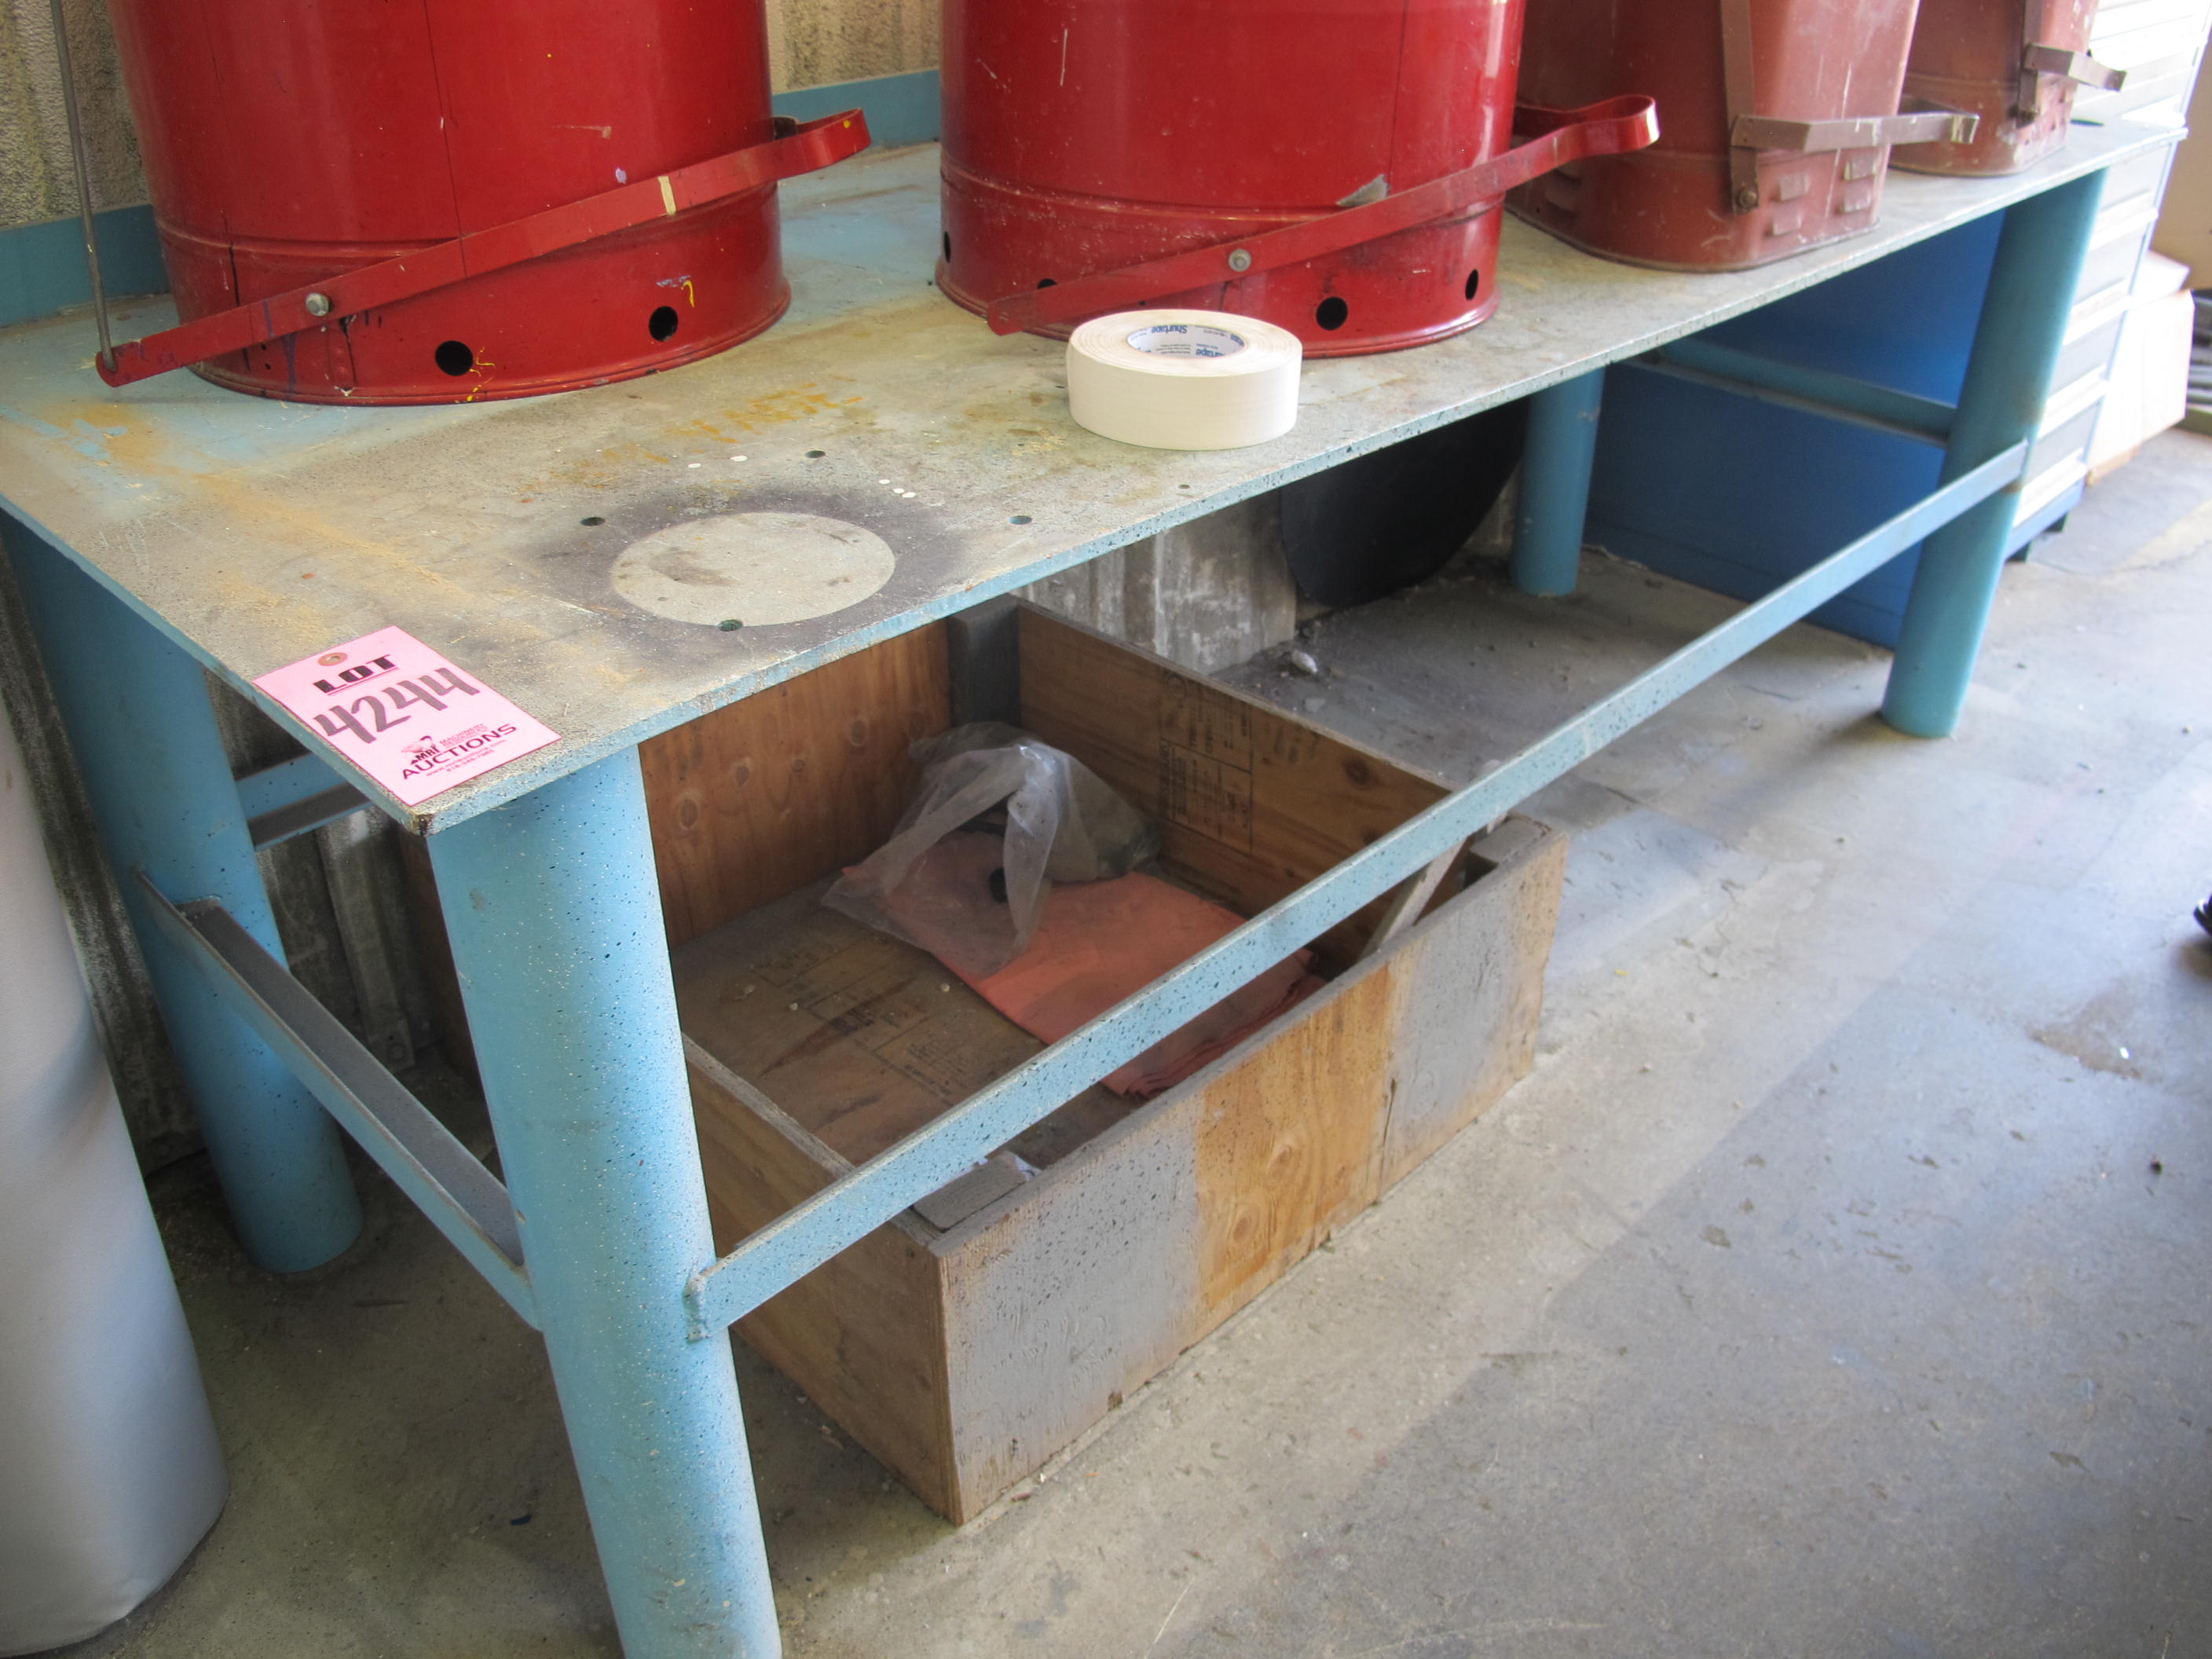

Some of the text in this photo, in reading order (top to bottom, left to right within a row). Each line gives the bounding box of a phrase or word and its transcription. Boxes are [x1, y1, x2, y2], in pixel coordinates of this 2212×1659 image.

[313, 654, 396, 694] LOT
[313, 668, 481, 744] 4244
[402, 723, 517, 780] AUCTIONS
[415, 745, 441, 761] MRI
